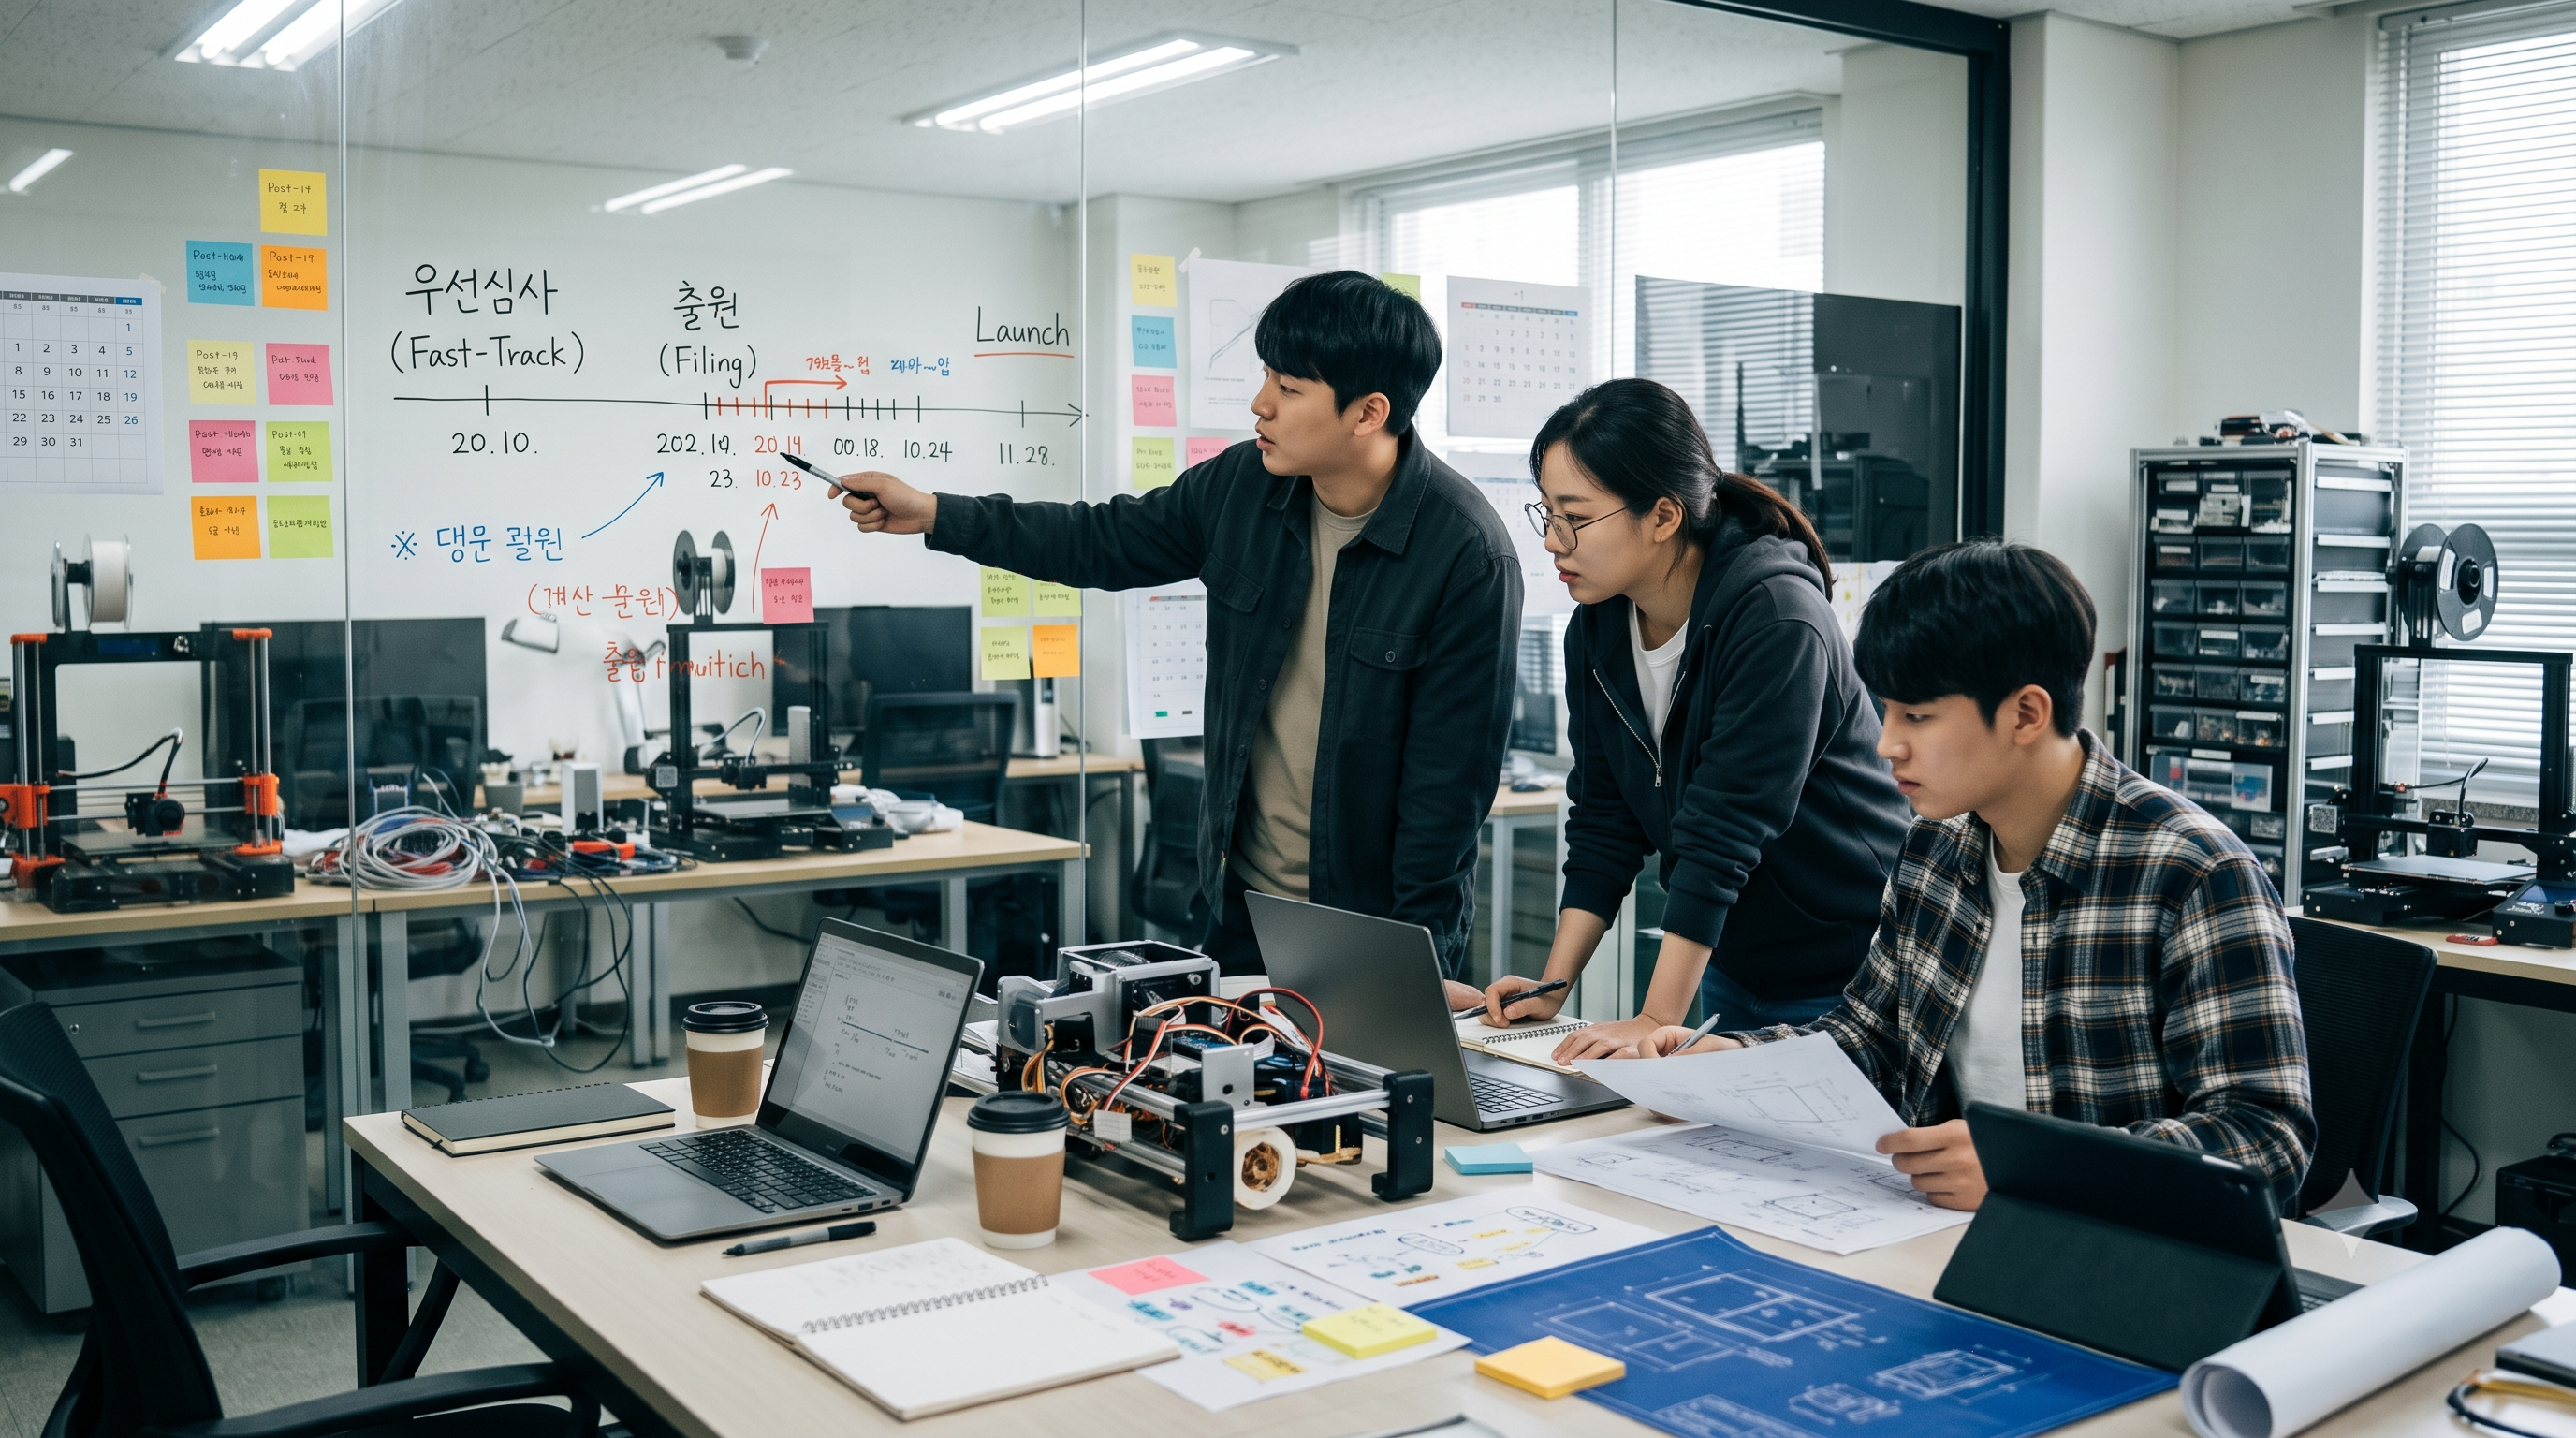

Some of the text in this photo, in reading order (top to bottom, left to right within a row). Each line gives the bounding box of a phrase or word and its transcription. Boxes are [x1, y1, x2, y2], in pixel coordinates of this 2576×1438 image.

[405, 264, 558, 315] 우선심사
[674, 280, 739, 330] 출원
[125, 323, 130, 331] 1
[975, 305, 1071, 348] Launch
[15, 343, 20, 351] 1
[43, 344, 50, 353] 2
[71, 345, 78, 354] 3
[126, 346, 133, 356] 5
[391, 331, 584, 374] (Fast-Track)
[15, 366, 137, 379] 8 9 10 11 12
[658, 342, 758, 389] (Filing)
[12, 389, 138, 402] 15 16 17 18 19
[13, 413, 139, 425] 22 23 24 25 26
[13, 436, 82, 447] 29 30 31
[452, 431, 537, 454] 20.10.
[904, 440, 952, 462] 10.24
